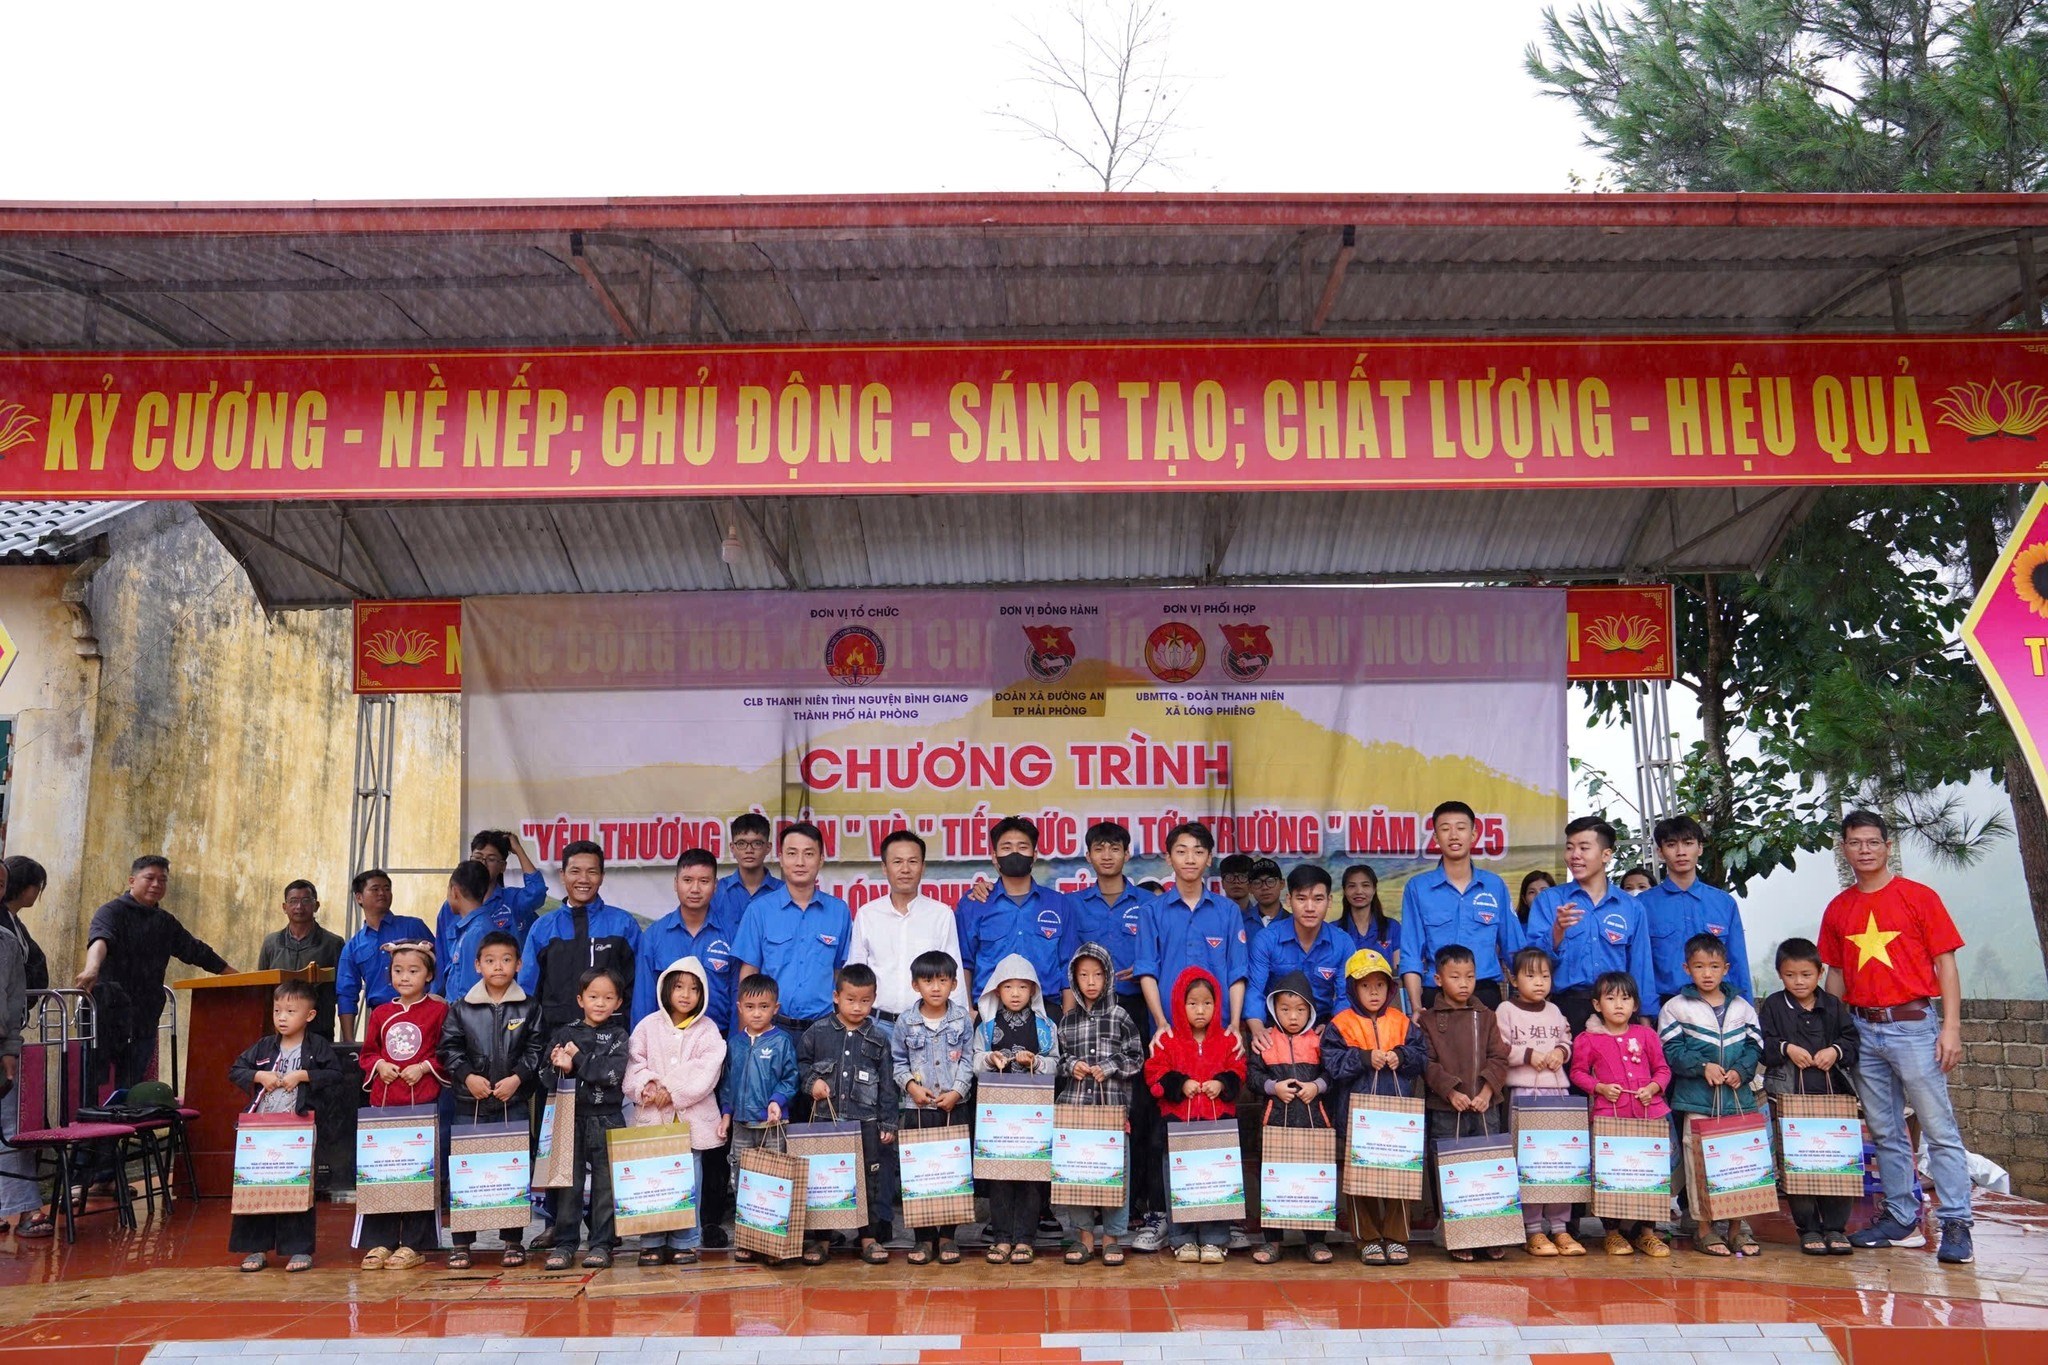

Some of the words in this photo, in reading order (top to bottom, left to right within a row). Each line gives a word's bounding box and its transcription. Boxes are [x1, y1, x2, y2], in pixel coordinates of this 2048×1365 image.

[44, 373, 121, 471] KỶ
[132, 379, 328, 471] CƯƠNG
[344, 429, 363, 444] -
[379, 364, 448, 470] NỀ
[463, 362, 585, 476] NẾP;
[601, 366, 718, 468] CHỦ
[736, 371, 892, 480] ĐỘNG
[911, 422, 931, 437] -
[948, 370, 1100, 464] SÁNG
[1118, 380, 1246, 477] TẠO;
[1264, 353, 1411, 461] CHẤT
[1429, 367, 1615, 473] LƯỢNG
[1631, 416, 1650, 431] -
[1665, 362, 1797, 472] HIỆU
[1812, 356, 1931, 465] QUẢ
[810, 608, 834, 618] ĐƠN
[838, 608, 848, 620] VỊ
[868, 605, 900, 617] CHỨC
[1000, 606, 1022, 615] ĐƠN
[1025, 606, 1035, 617] VỊ
[1070, 604, 1098, 615] HÀNH
[1163, 604, 1187, 613] ĐƠN
[1190, 604, 1201, 615] VỊ
[1204, 602, 1230, 613] PHỐI
[1233, 604, 1256, 616] HỢP
[743, 697, 764, 706] CLB
[766, 696, 801, 706] THANH
[805, 694, 829, 705] NIÊN
[831, 694, 855, 705] TÌNH
[858, 693, 901, 707] NGUYỆN
[904, 693, 930, 704] BÌNH
[932, 693, 969, 703] GIANG
[995, 690, 1027, 701] ĐOÀN
[1047, 689, 1087, 701] ĐƯỜNG
[1090, 692, 1105, 701] AN
[1136, 691, 1178, 701] UBMTTQ
[1187, 690, 1218, 701] ĐOÀN
[1221, 691, 1257, 700] THANH
[1260, 690, 1285, 700] NIÊN
[793, 709, 829, 720] THÀNH
[832, 706, 855, 720] PHỐ
[858, 708, 877, 719] HẢI
[880, 708, 919, 719] PHÒNG
[1013, 707, 1025, 715] TP
[1048, 704, 1087, 715] PHÒNG
[1216, 705, 1256, 715] PHIÊNG
[801, 740, 1053, 789] CHƯƠNG
[1070, 732, 1229, 787] TRÌNH
[600, 816, 721, 860] THƯƠNG
[1350, 809, 1416, 855] NĂM
